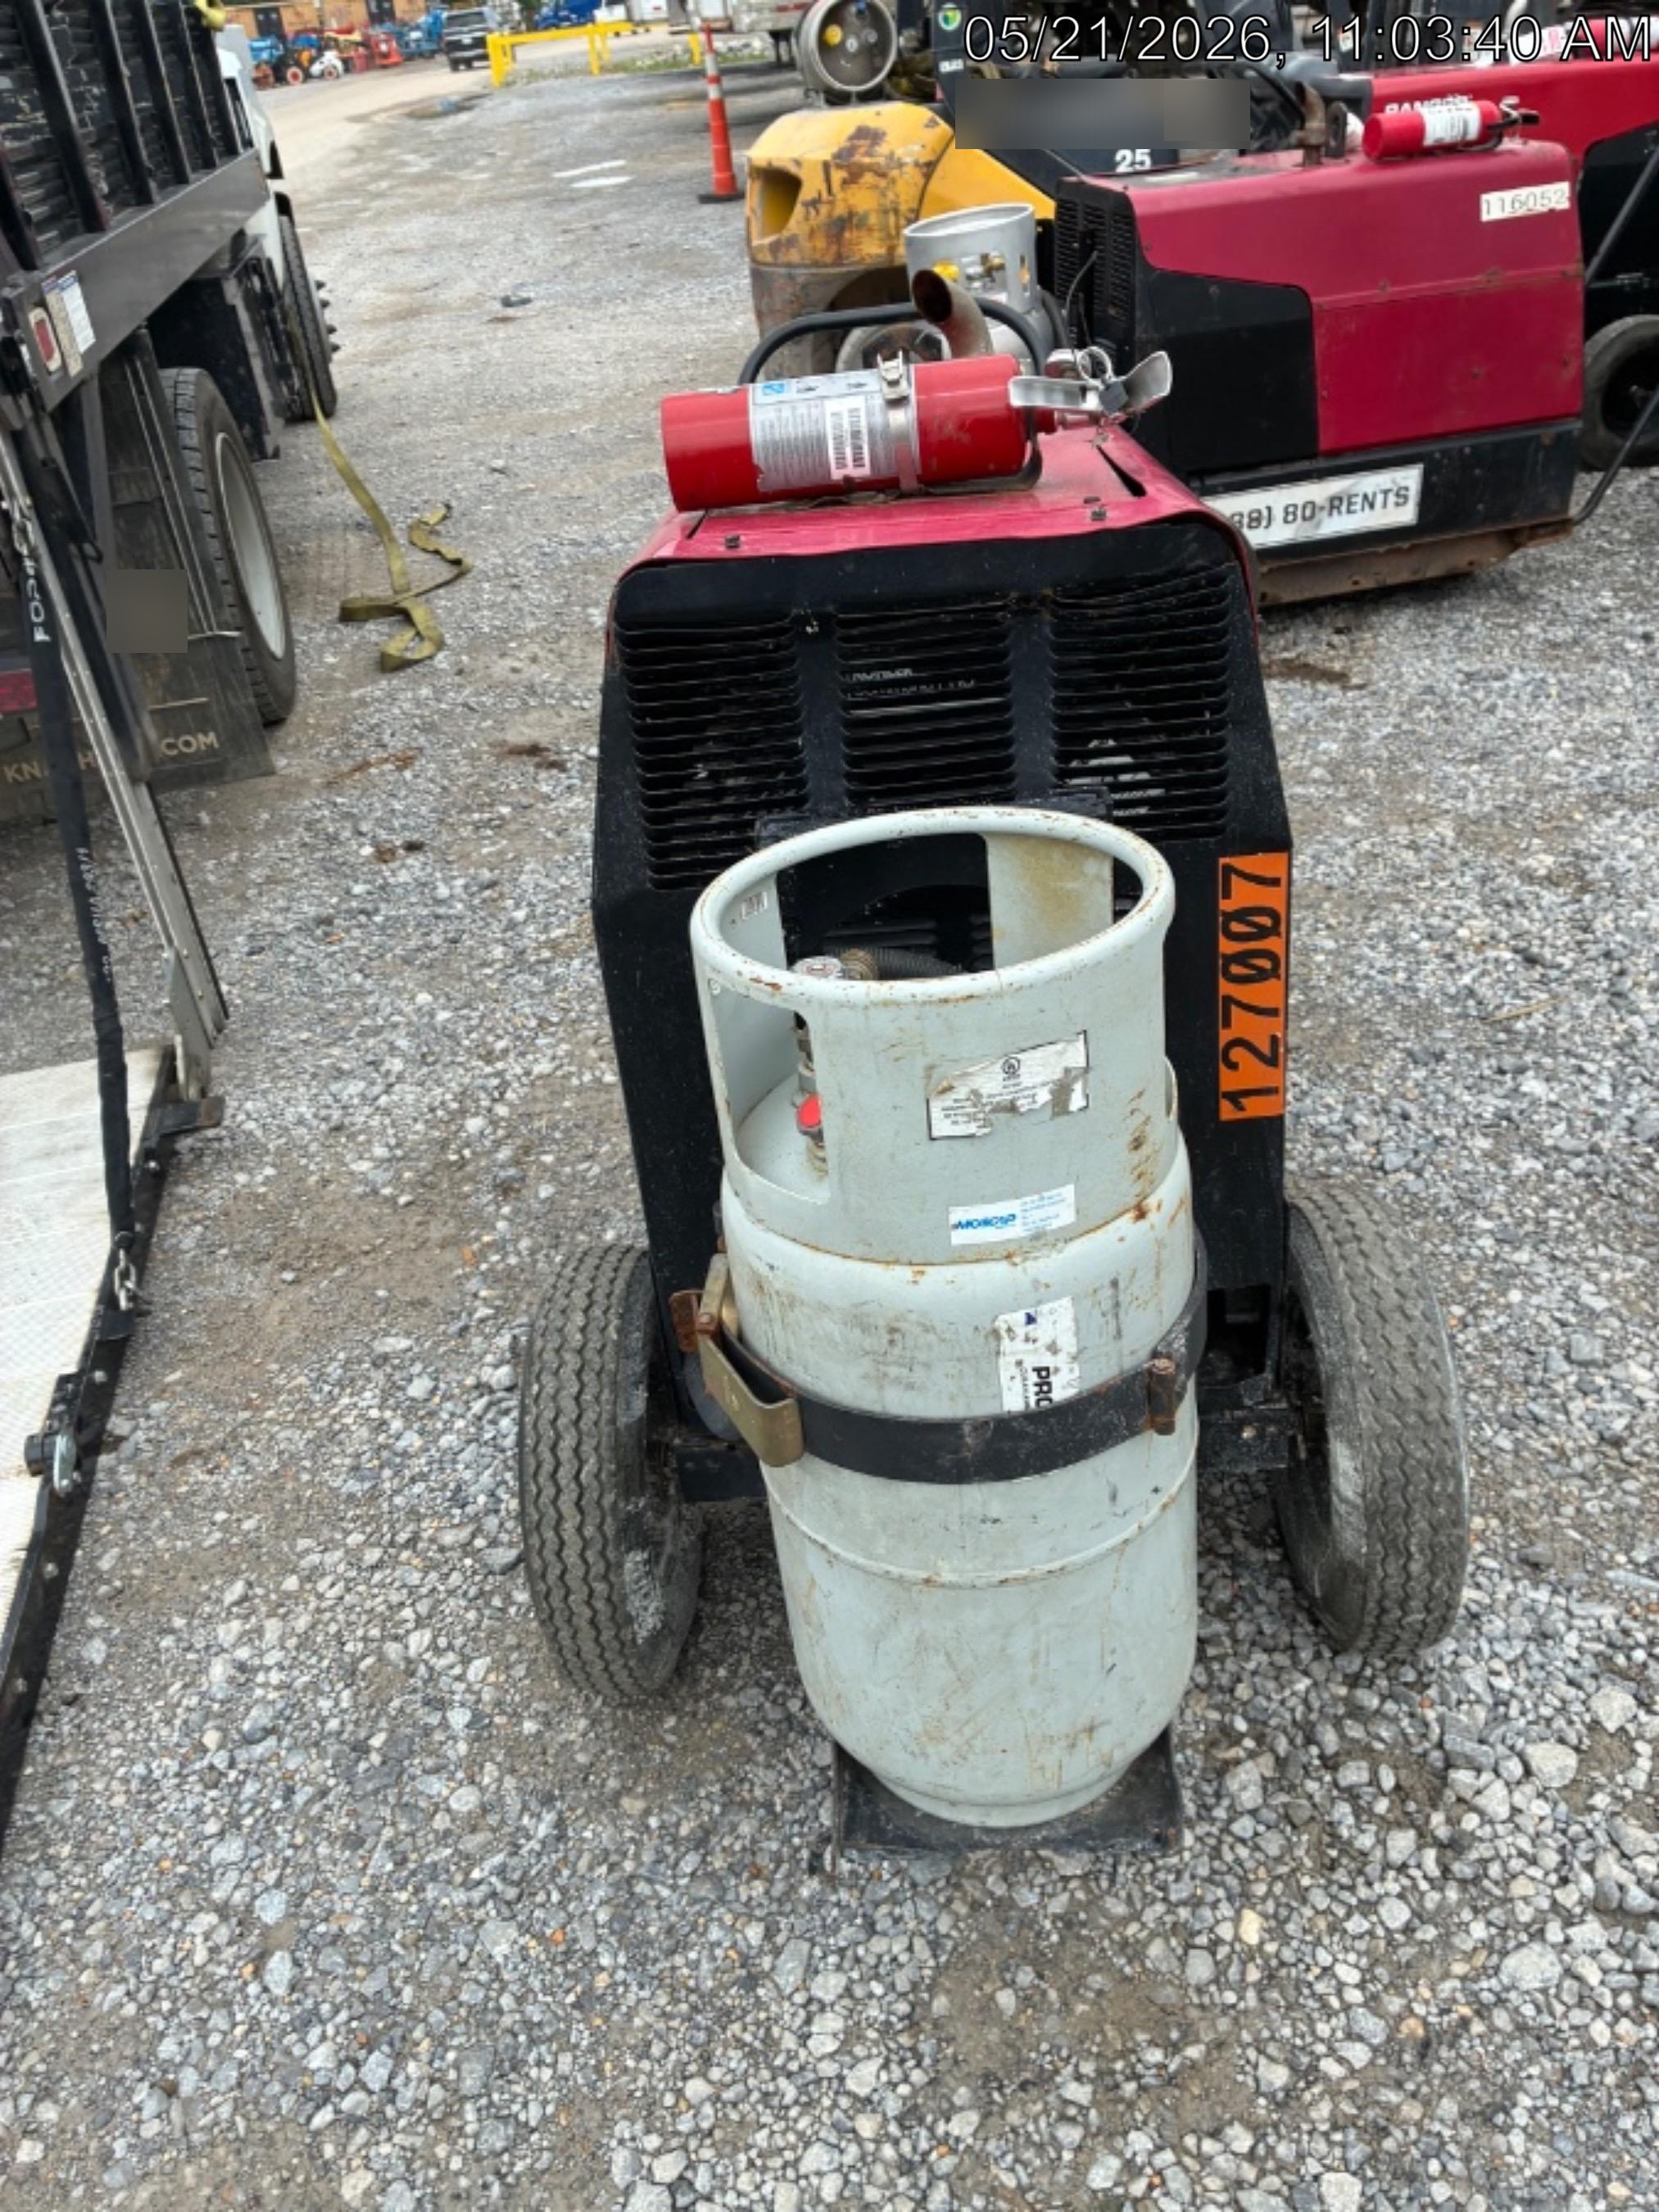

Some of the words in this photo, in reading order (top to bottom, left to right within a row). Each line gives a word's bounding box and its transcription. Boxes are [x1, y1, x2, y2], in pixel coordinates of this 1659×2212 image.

[1115, 149, 1151, 172] 25
[1282, 486, 1410, 525] 80-RENTS
[1221, 863, 1282, 1113] 127007
